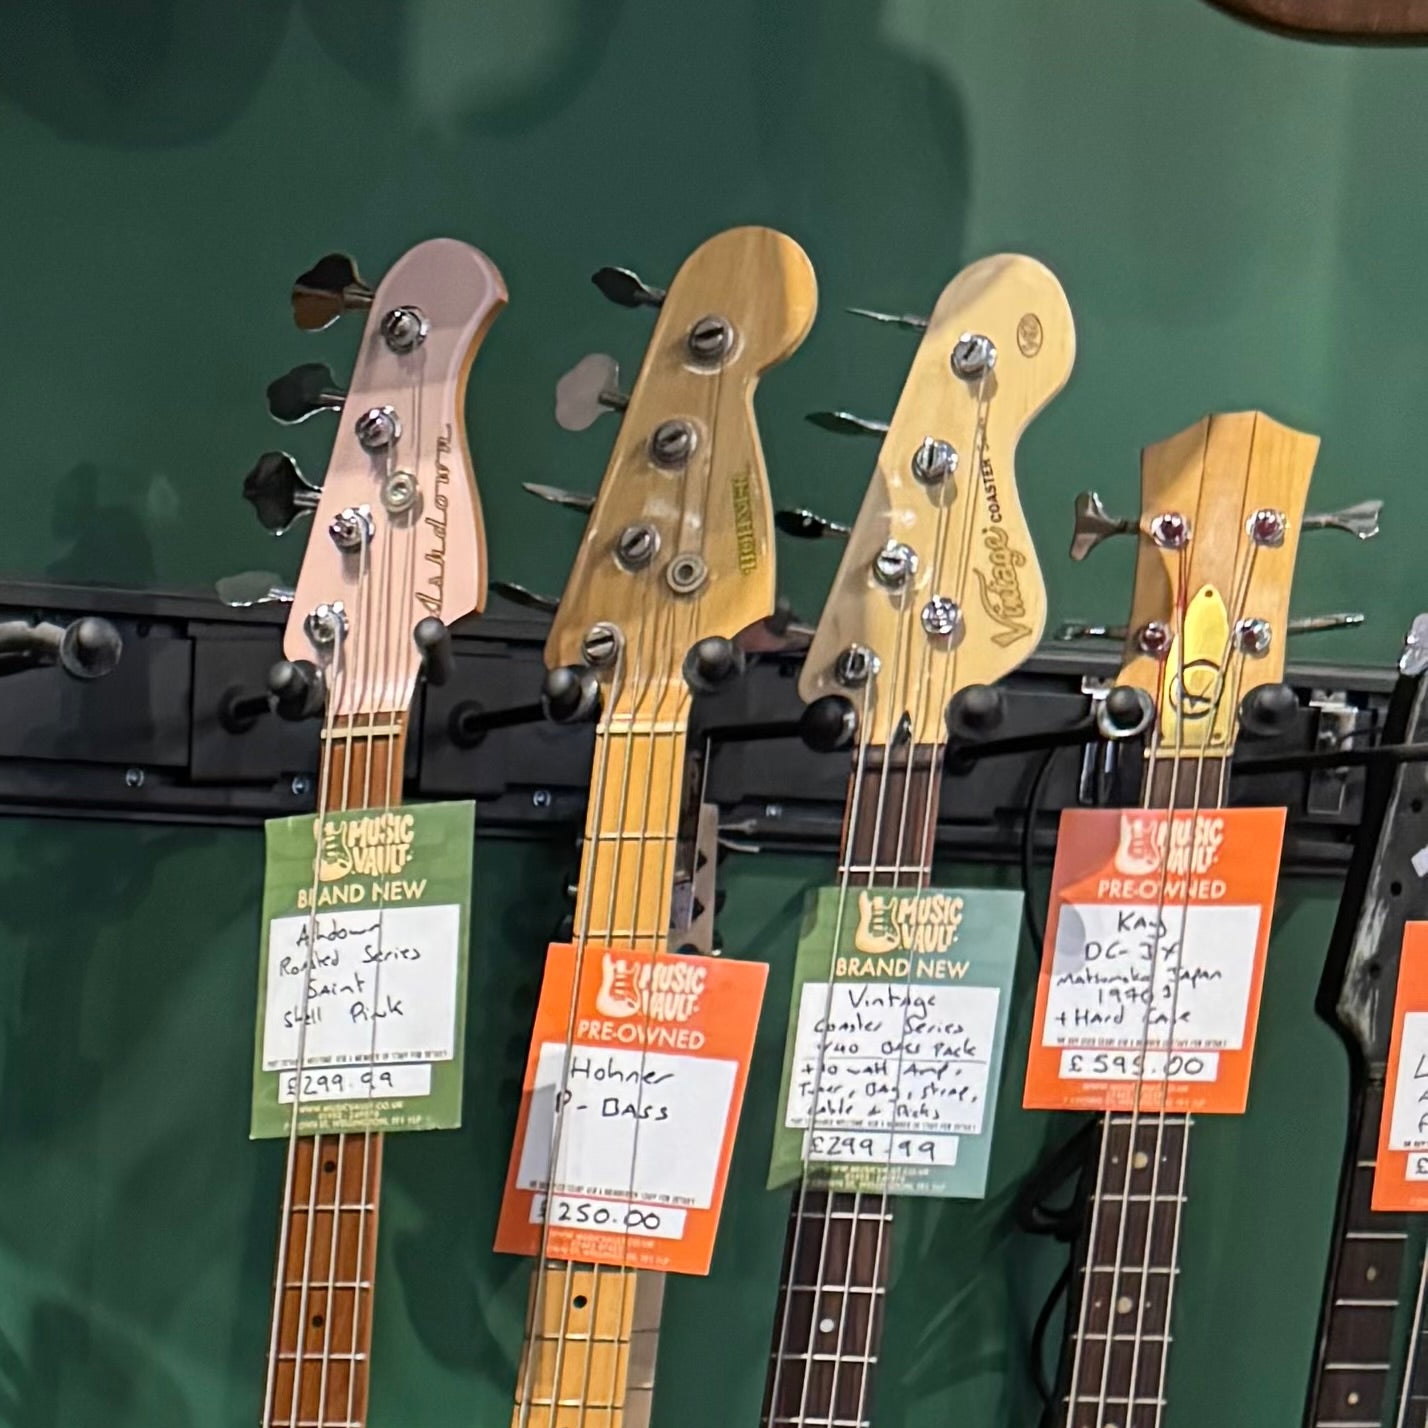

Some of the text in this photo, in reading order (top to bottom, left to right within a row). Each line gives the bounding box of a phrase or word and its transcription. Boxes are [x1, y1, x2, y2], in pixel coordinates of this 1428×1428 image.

[416, 423, 452, 616] Ashdown
[973, 456, 1035, 649] Vintage COASTER
[347, 812, 415, 848] MUSIC
[1157, 816, 1224, 848] MUSIC
[351, 843, 408, 877] VAULT
[372, 879, 427, 902] NEW
[1097, 879, 1227, 900] PRE-OWNED
[898, 894, 964, 927] MUSIC
[296, 919, 381, 947] Ahdown
[901, 923, 955, 953] VAULT
[640, 961, 706, 995] MUSIC
[836, 957, 970, 980] BRAND NEW
[641, 990, 697, 1023] VAULT
[576, 1019, 705, 1050] PRE-OWNED
[571, 1055, 676, 1086] Hohner
